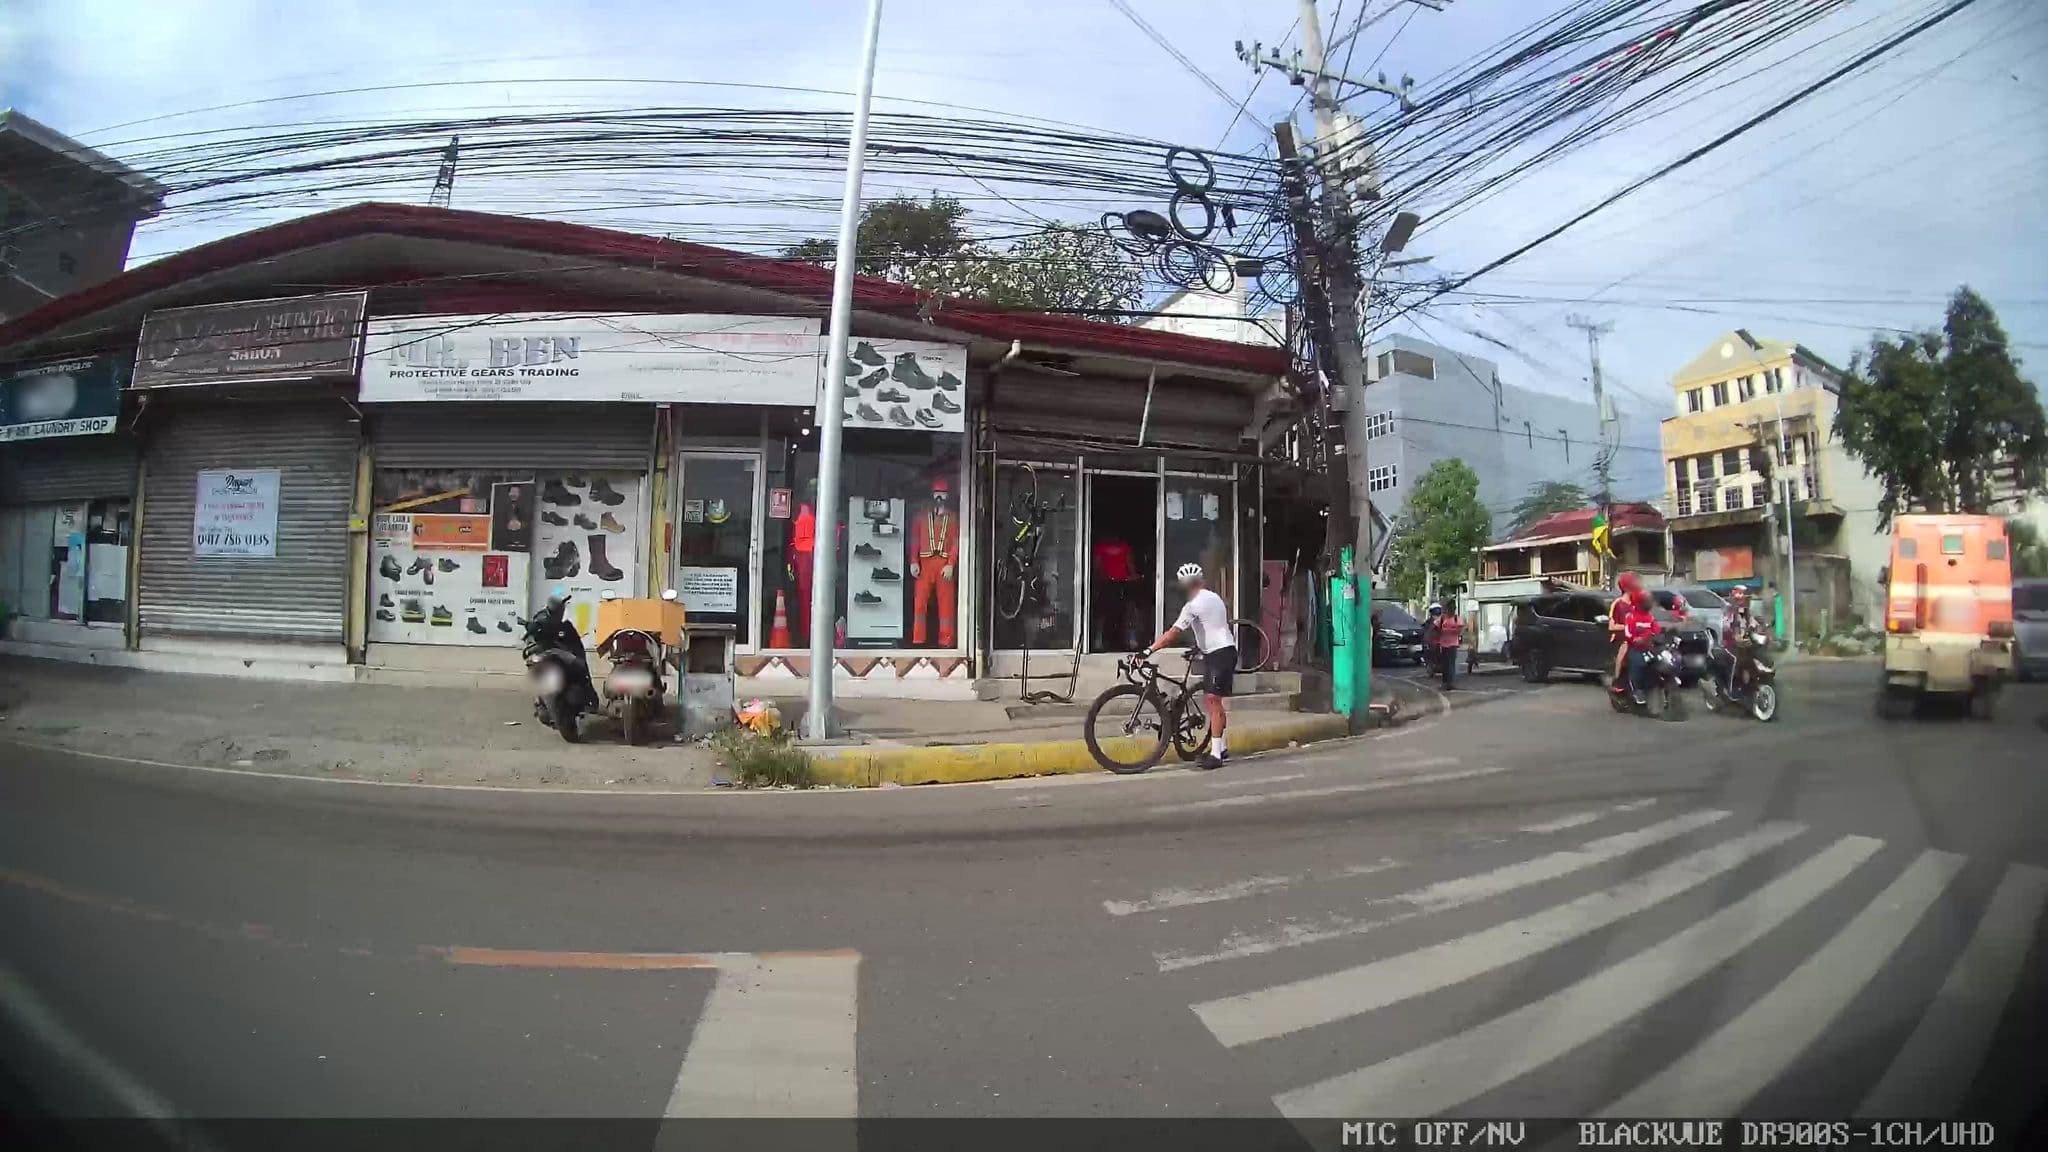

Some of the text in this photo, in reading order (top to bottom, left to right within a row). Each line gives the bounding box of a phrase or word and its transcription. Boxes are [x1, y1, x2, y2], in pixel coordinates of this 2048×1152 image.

[487, 335, 582, 368] BEN
[389, 368, 580, 378] PROTECTIVE GEARS TRADING
[35, 422, 76, 435] LAUNDRY
[80, 420, 108, 432] SHOP
